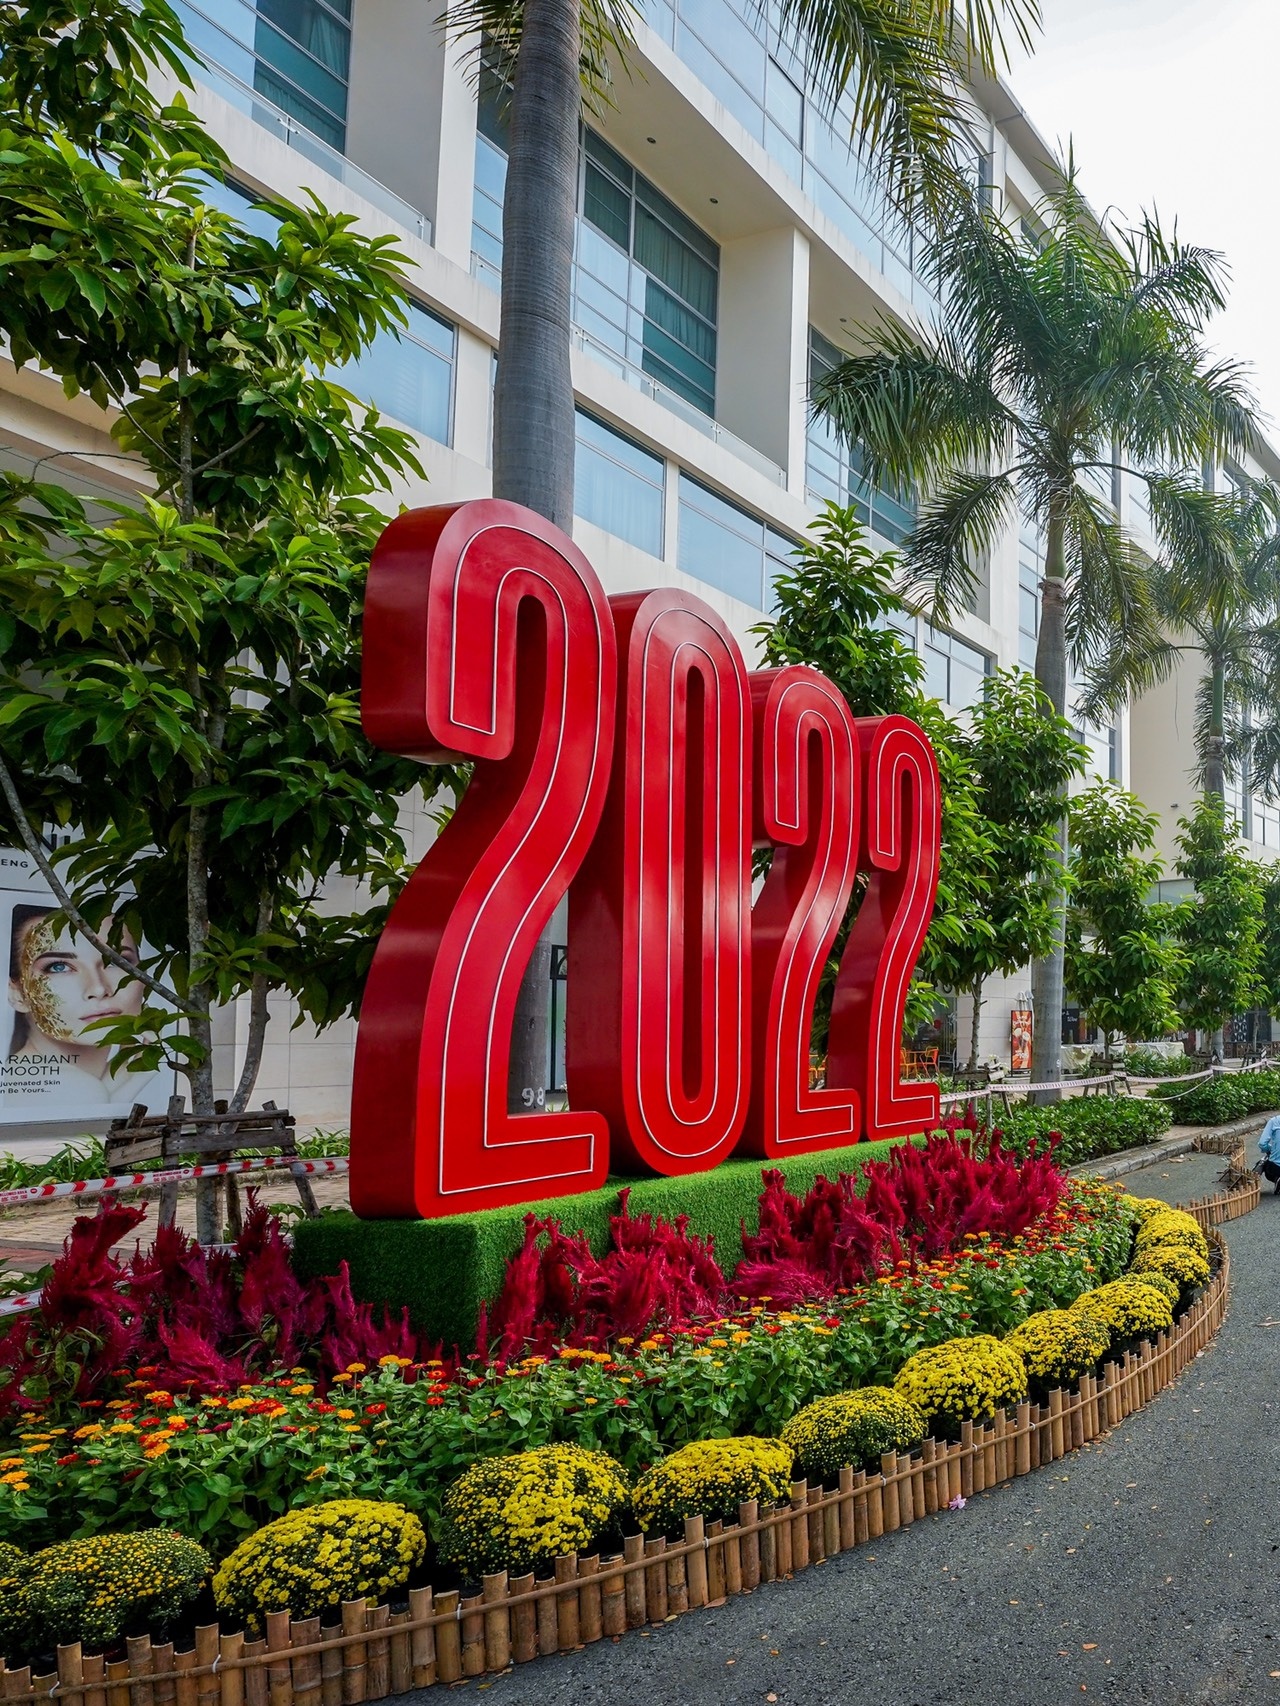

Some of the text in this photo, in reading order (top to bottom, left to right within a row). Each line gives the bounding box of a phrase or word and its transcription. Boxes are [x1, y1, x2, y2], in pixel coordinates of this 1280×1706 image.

[1, 858, 28, 869] ENG
[350, 498, 941, 1220] 2022
[8, 1054, 80, 1064] RADIANT
[1, 1066, 60, 1076] MOOTH
[521, 1086, 545, 1107] 98
